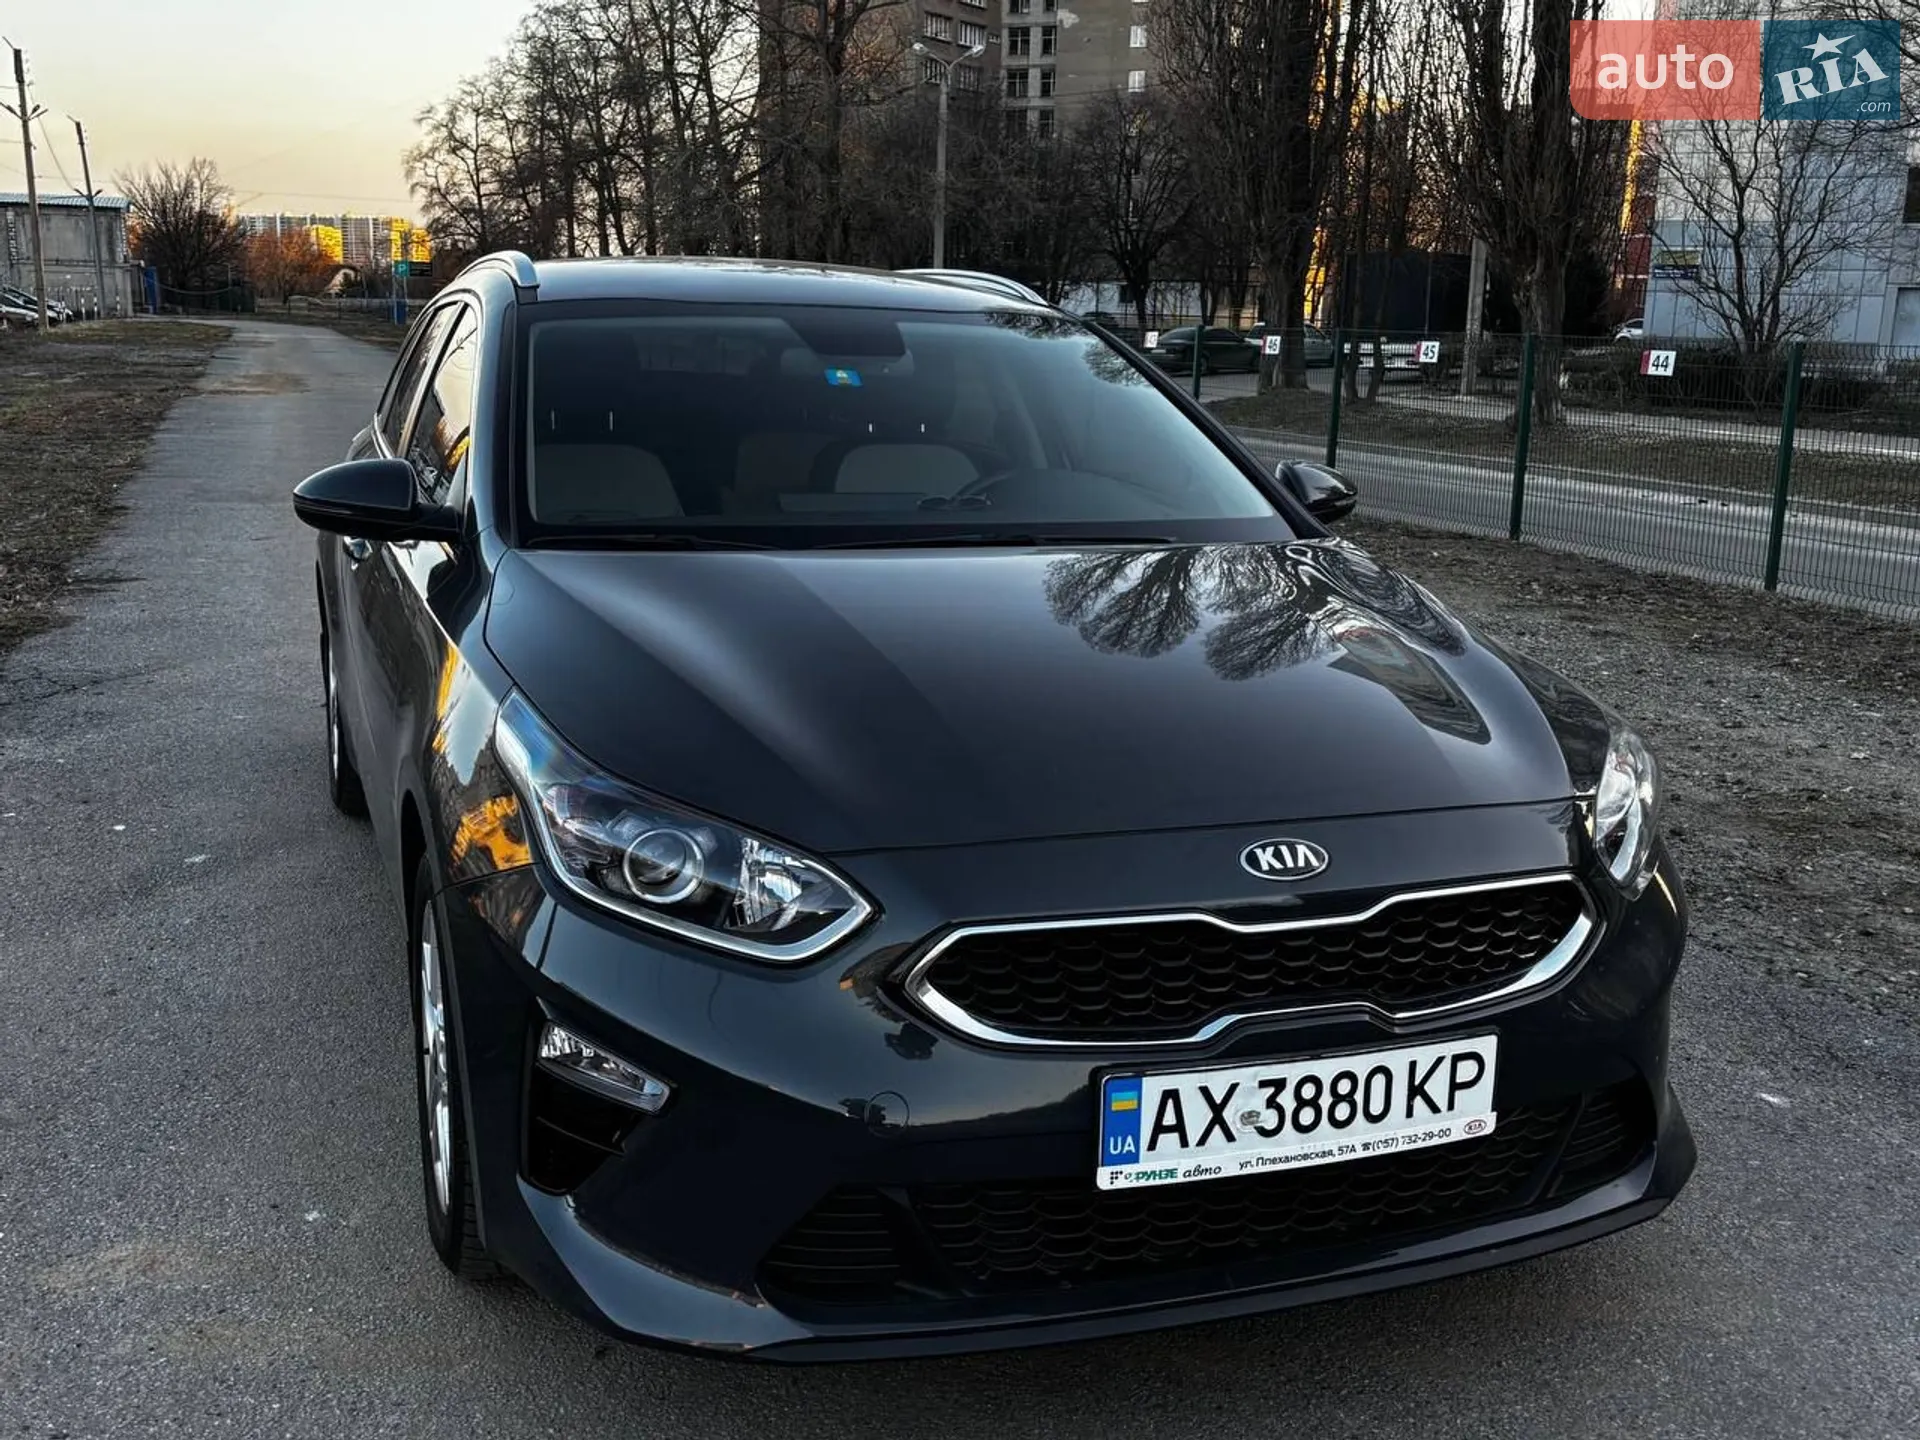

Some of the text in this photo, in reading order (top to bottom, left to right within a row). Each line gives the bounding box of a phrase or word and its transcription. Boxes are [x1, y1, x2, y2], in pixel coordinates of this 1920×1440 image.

[1422, 344, 1436, 360] 45
[1652, 355, 1669, 371] 44
[1253, 844, 1320, 871] KIA
[1147, 1051, 1486, 1152] AX 3880 KP
[1109, 1135, 1136, 1154] UA
[1182, 1164, 1222, 1179] авто
[1337, 1144, 1357, 1156] 57А
